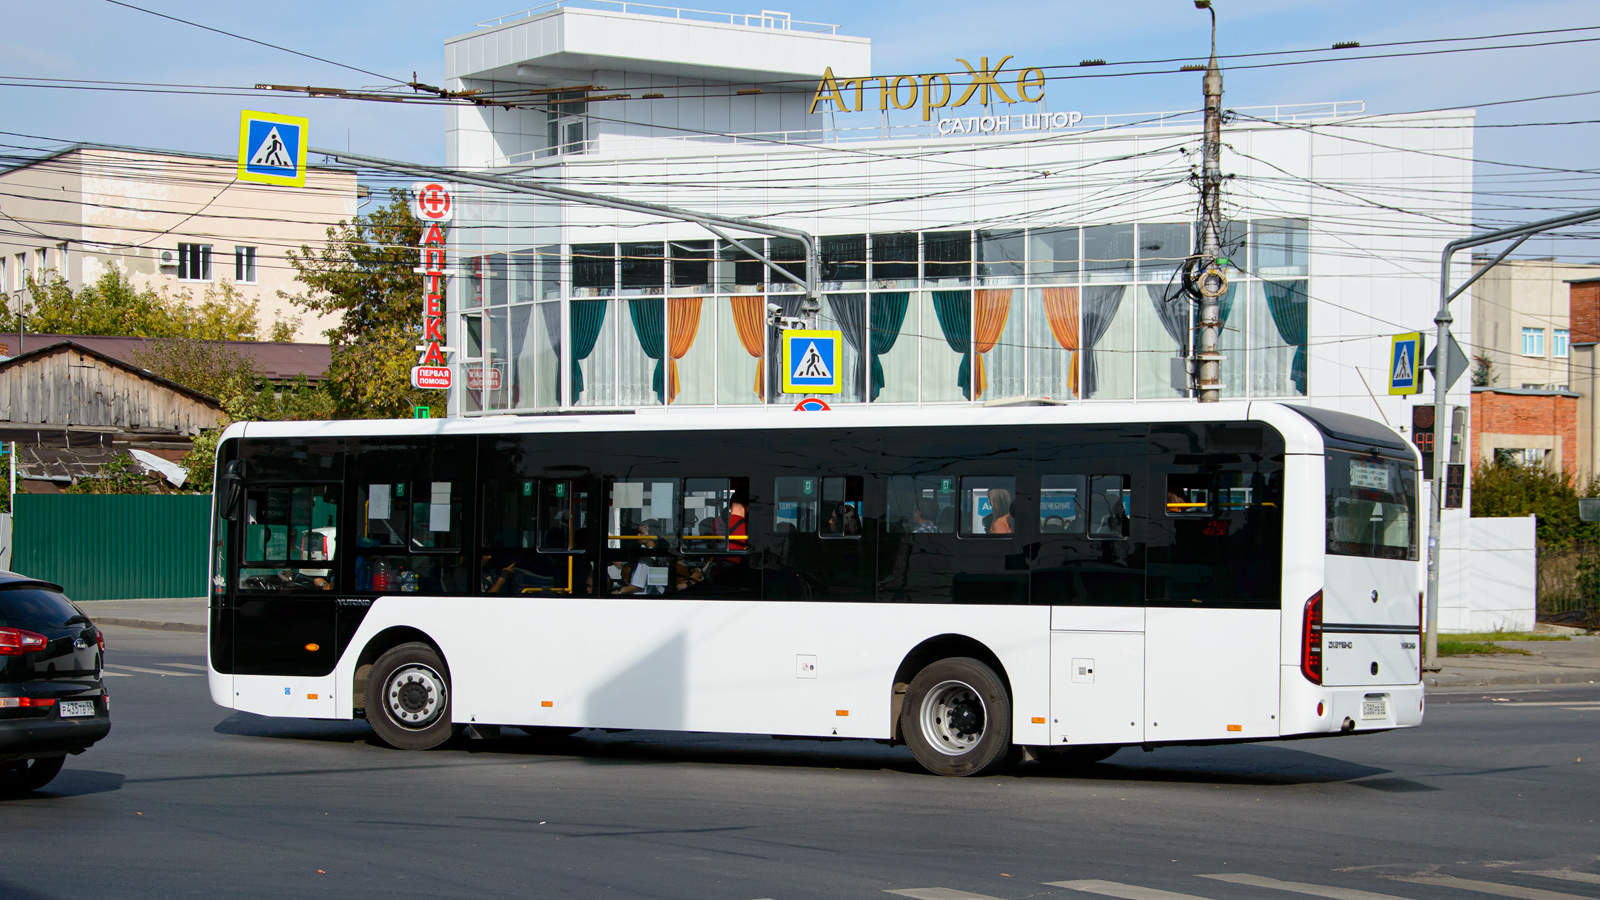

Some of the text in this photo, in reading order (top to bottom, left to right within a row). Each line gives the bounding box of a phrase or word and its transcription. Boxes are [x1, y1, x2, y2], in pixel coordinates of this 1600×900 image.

[938, 111, 1083, 135] САЛОН ШТОР
[424, 223, 446, 364] АПТЕКА
[419, 369, 449, 378] ПЕРВАЯ
[419, 378, 449, 386] ПОМОЩЬ
